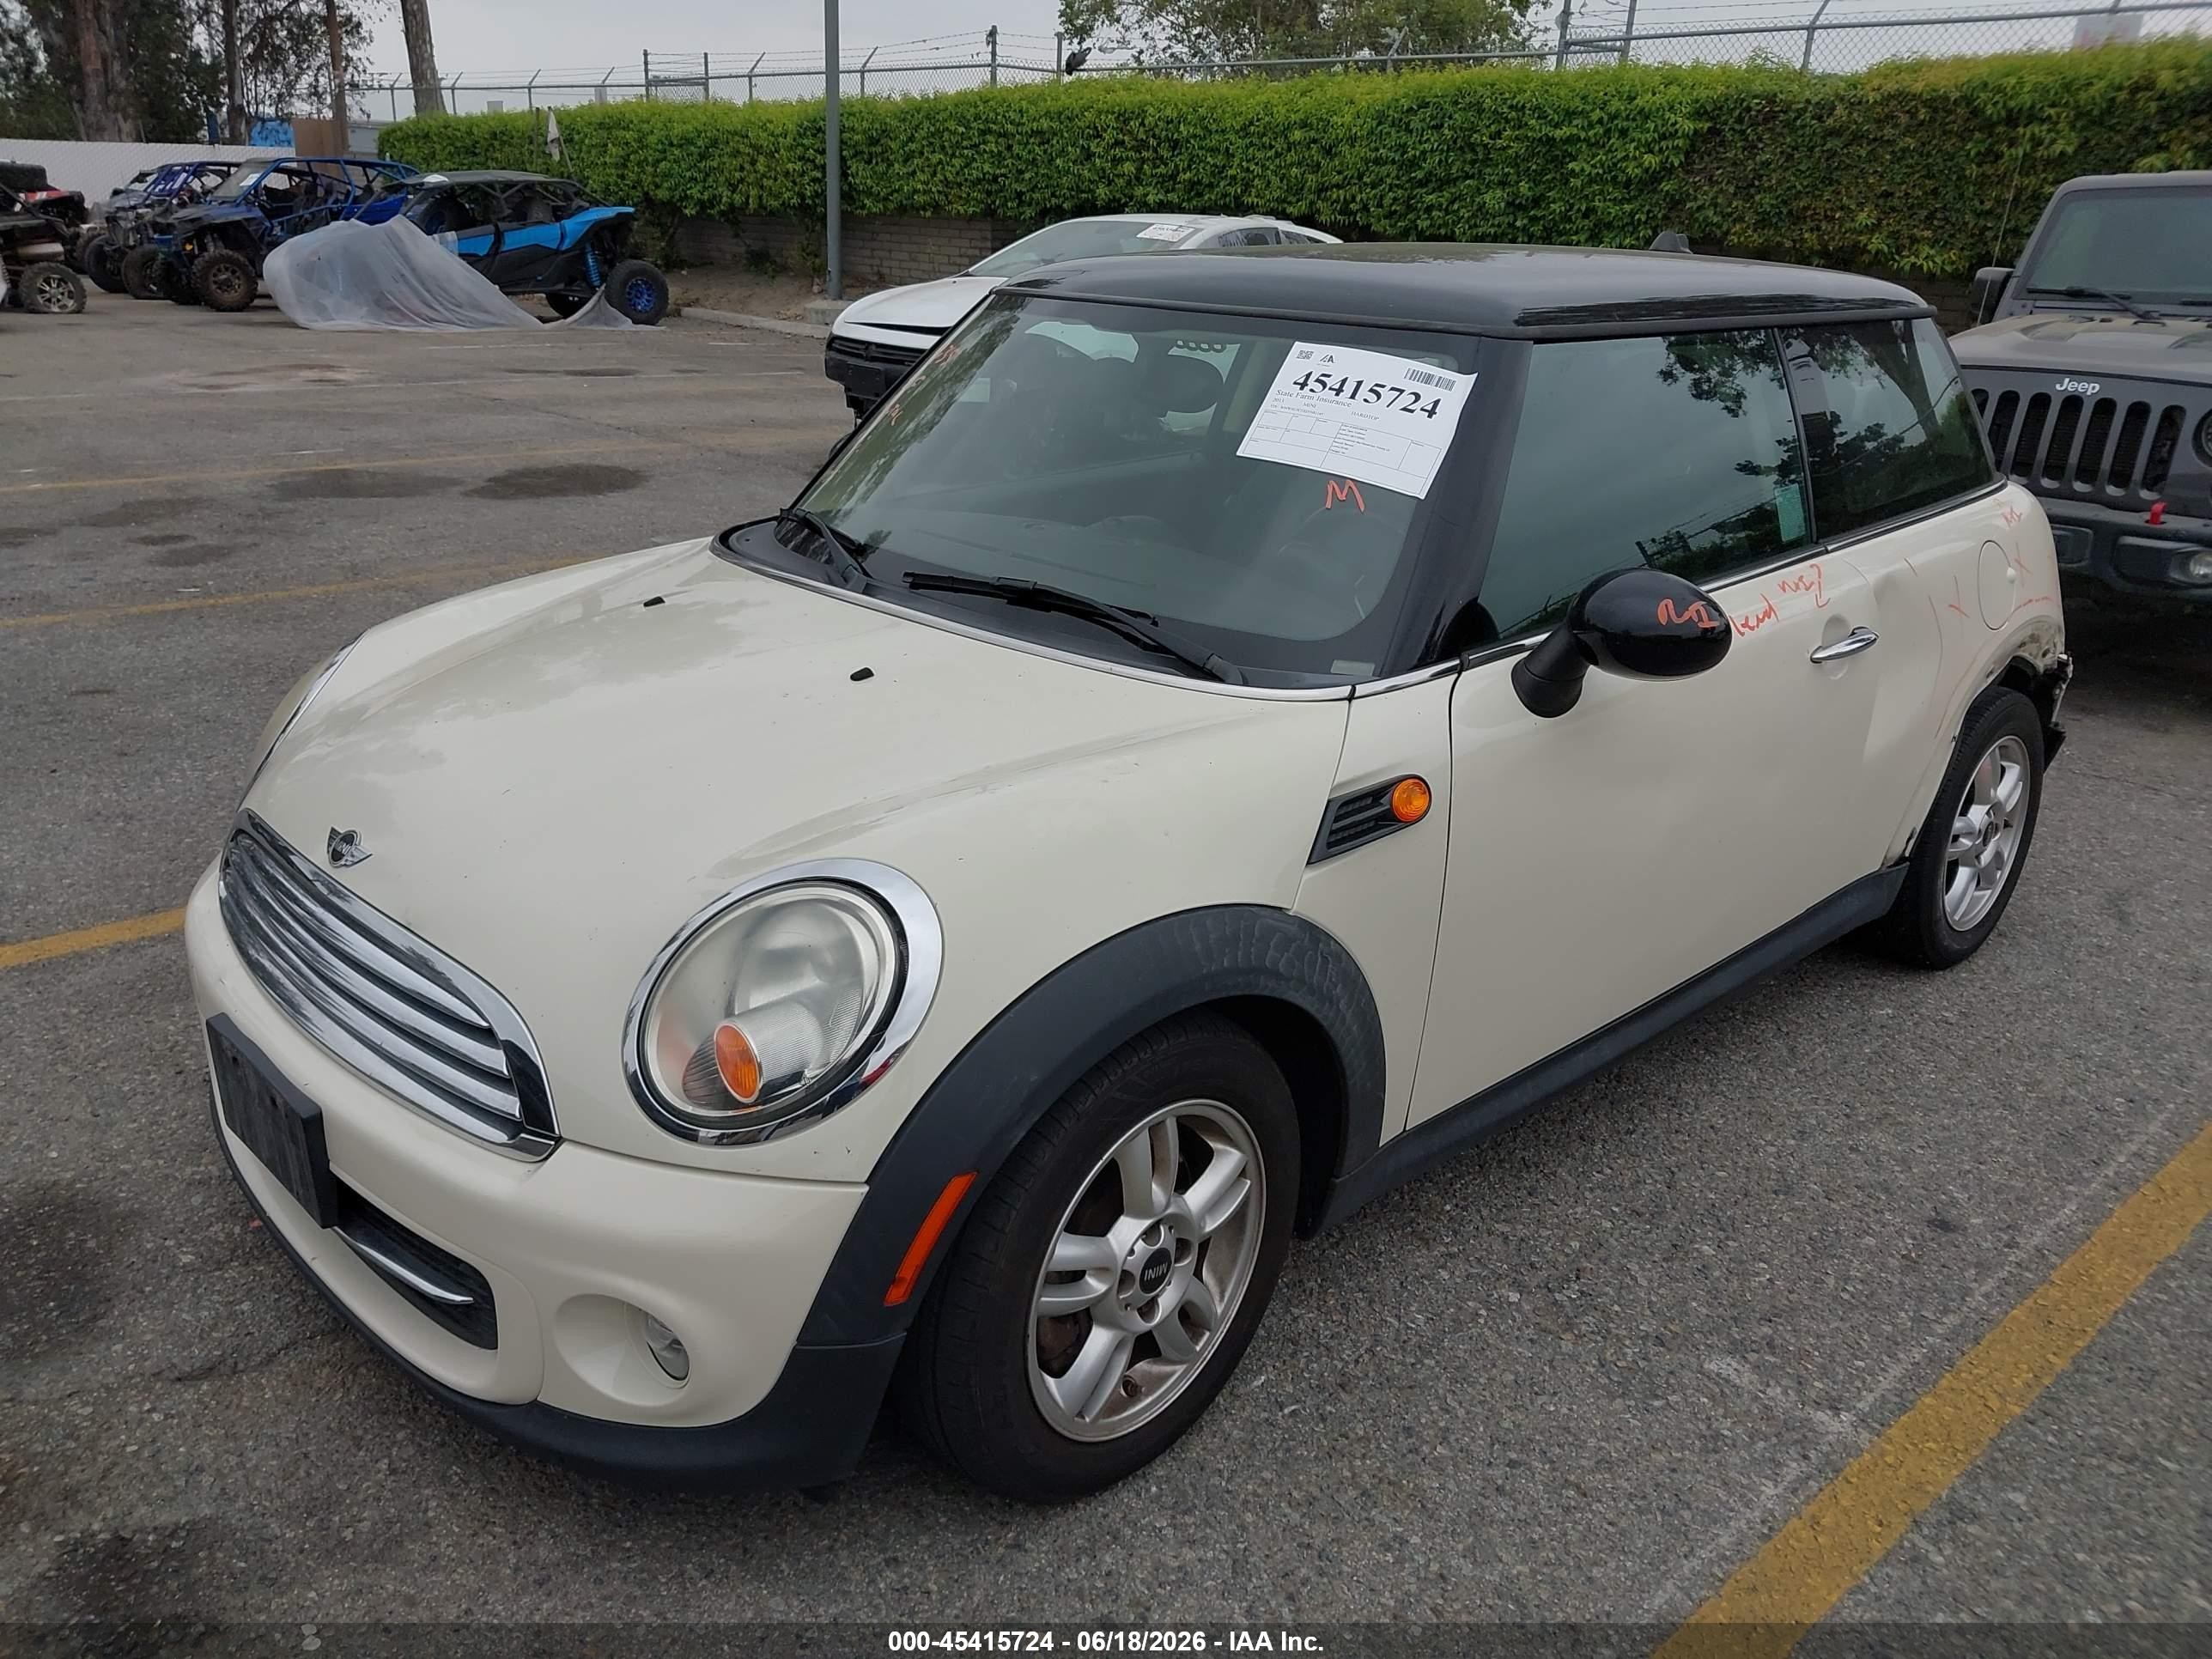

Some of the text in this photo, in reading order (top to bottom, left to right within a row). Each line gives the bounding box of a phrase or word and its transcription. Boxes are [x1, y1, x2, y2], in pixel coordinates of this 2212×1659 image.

[1292, 371, 1442, 420] 45415724
[2055, 378, 2100, 396] Jeep
[1276, 389, 1352, 408] State Farm Insurance
[1144, 1261, 1169, 1281] MINI
